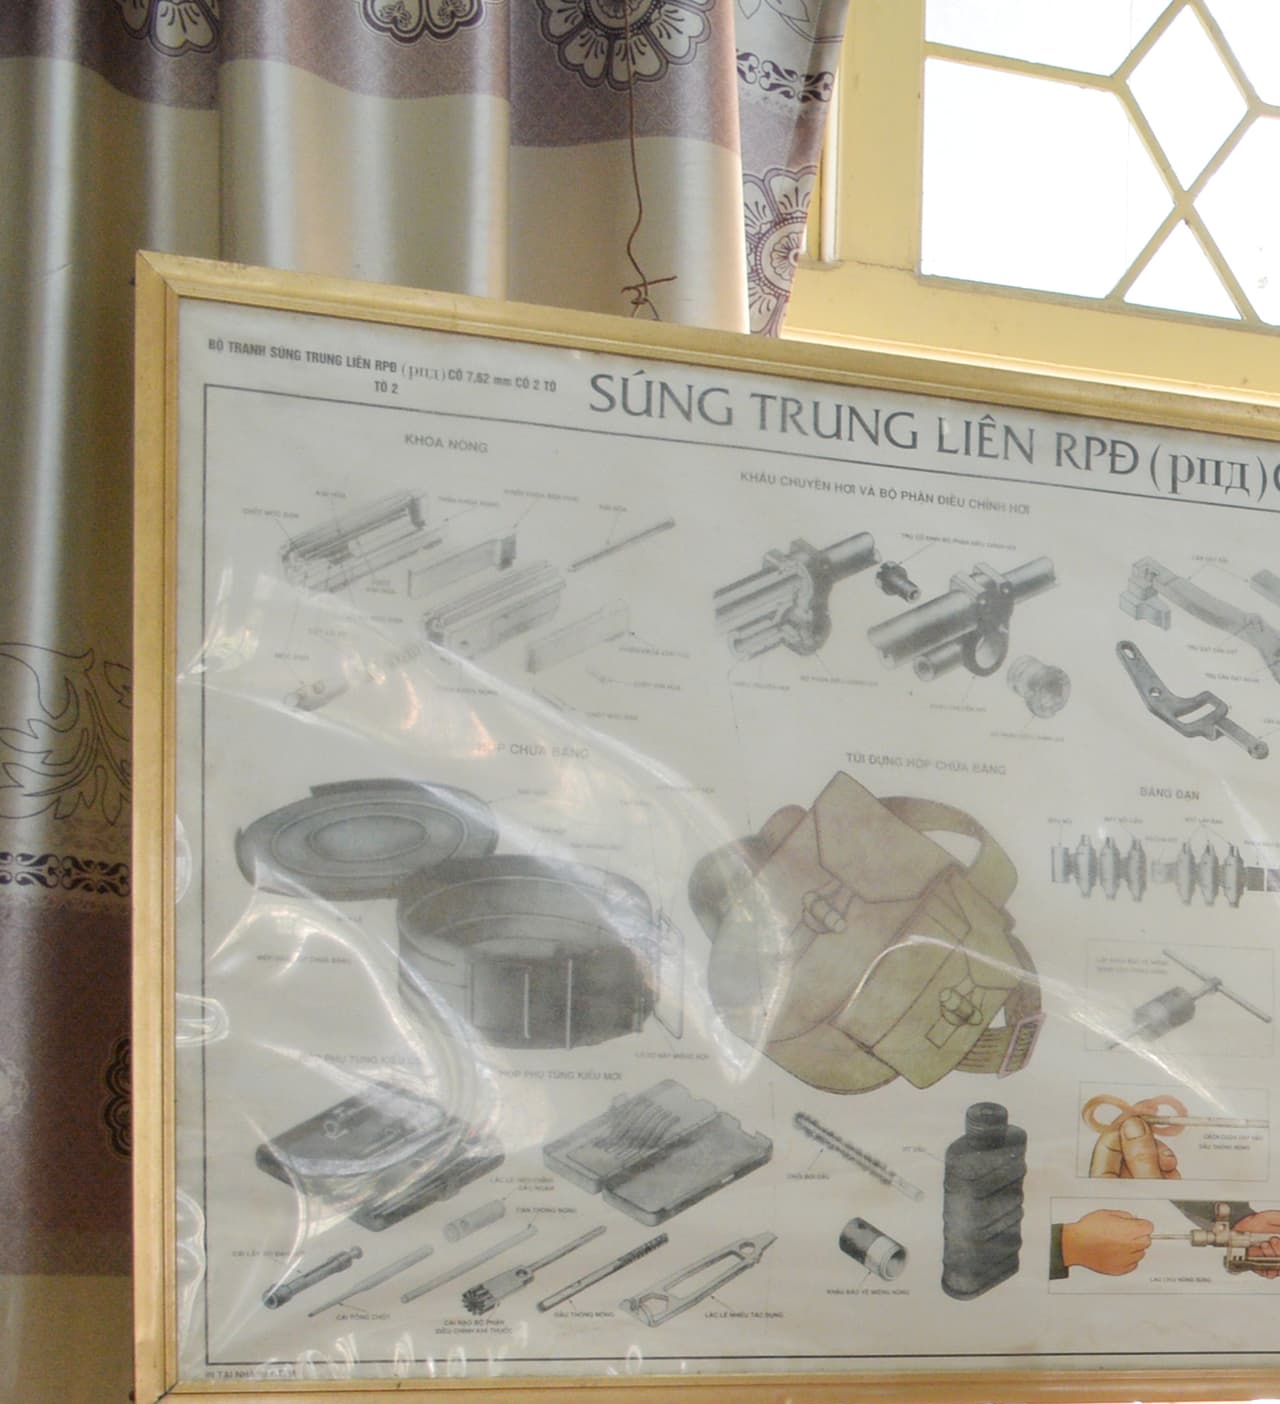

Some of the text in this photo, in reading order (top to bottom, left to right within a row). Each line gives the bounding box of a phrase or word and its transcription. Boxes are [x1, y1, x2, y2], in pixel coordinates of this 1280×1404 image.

[228, 341, 266, 356] TRANH
[270, 344, 301, 361] SÚNG
[306, 350, 342, 367] TRUNG
[346, 354, 371, 371] LIÊN
[533, 378, 540, 391] 2
[391, 382, 399, 394] 2
[589, 369, 733, 427] SÚNG
[750, 392, 919, 450] TRUNG
[937, 413, 1035, 465] LIÊN
[1055, 431, 1139, 476] RPĐ
